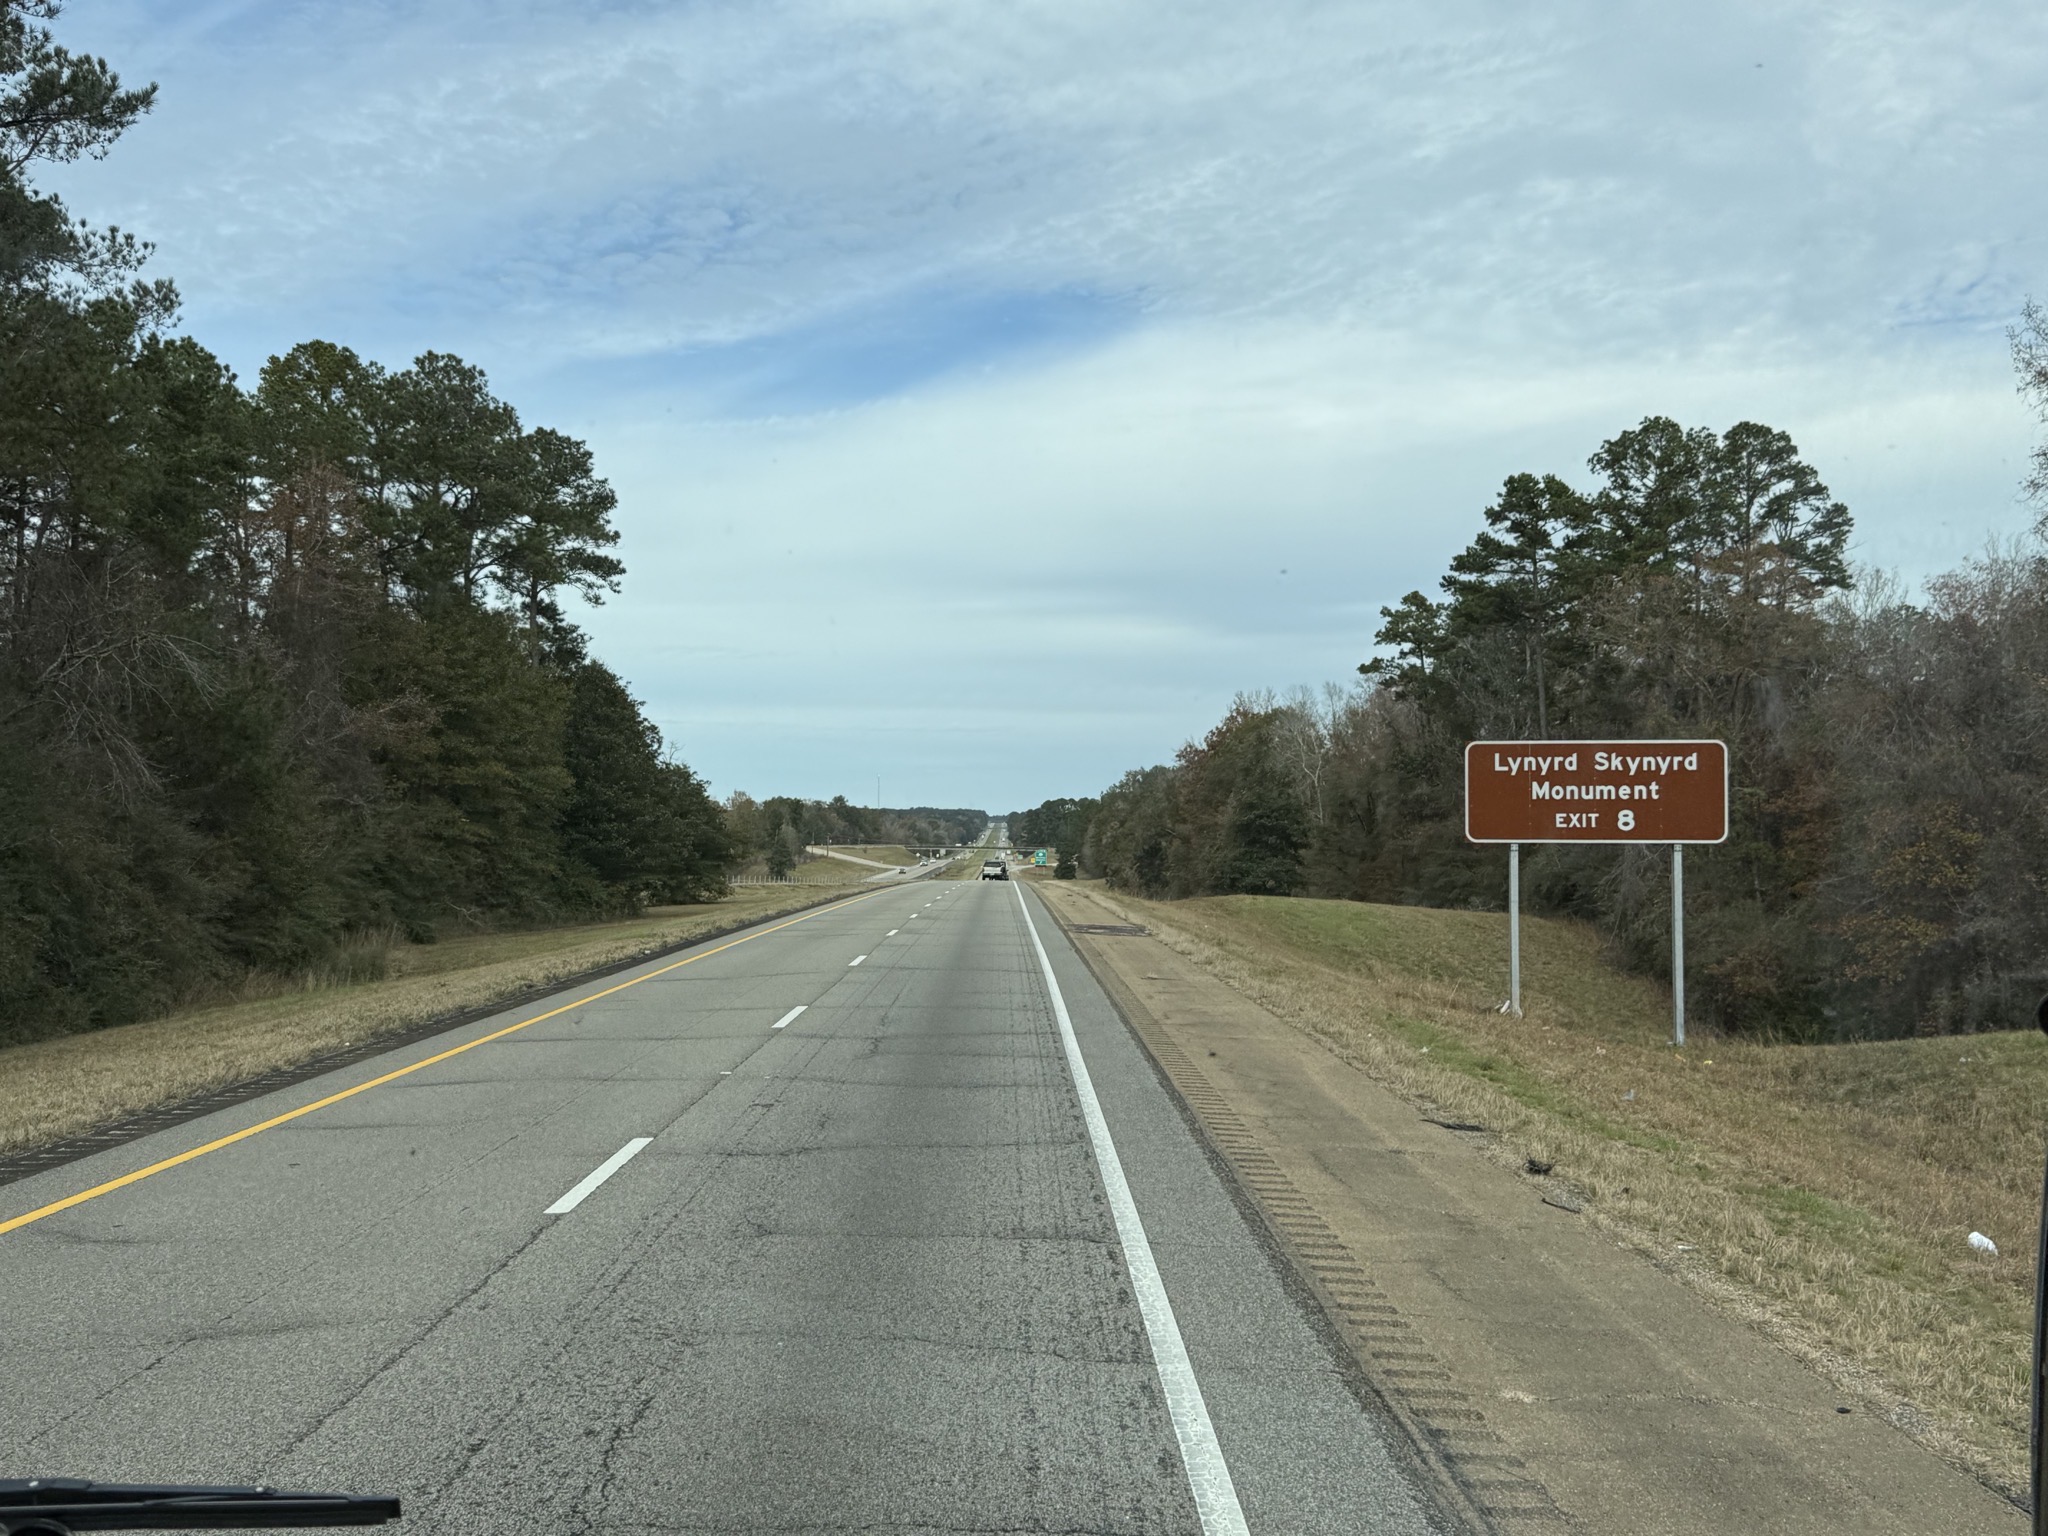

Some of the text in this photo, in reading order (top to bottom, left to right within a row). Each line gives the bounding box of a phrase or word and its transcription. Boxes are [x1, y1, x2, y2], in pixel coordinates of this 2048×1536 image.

[1494, 751, 1698, 776] Lynyrd Skynyrd
[1531, 781, 1660, 800] Monument
[1555, 809, 1636, 832] EXIT 8
